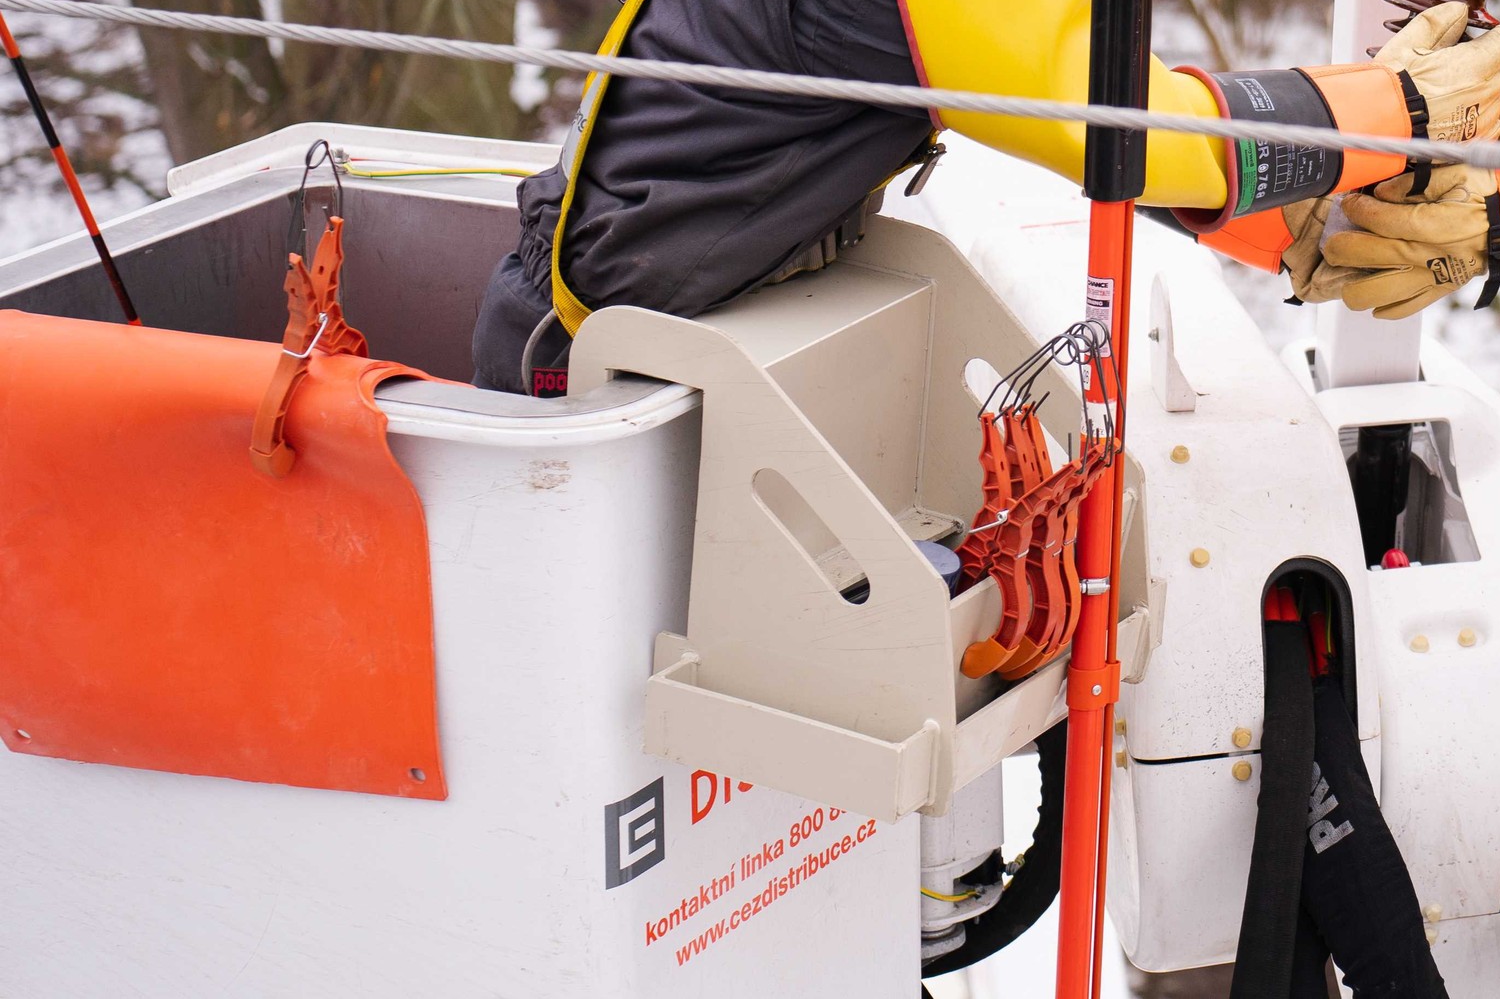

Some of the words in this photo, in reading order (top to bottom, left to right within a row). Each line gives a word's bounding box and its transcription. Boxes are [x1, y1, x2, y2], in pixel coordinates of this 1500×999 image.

[645, 863, 735, 947] kontaktní
[740, 838, 784, 882] linka
[789, 807, 824, 848] 800
[675, 817, 877, 966] www.cezdistribuce.cz
